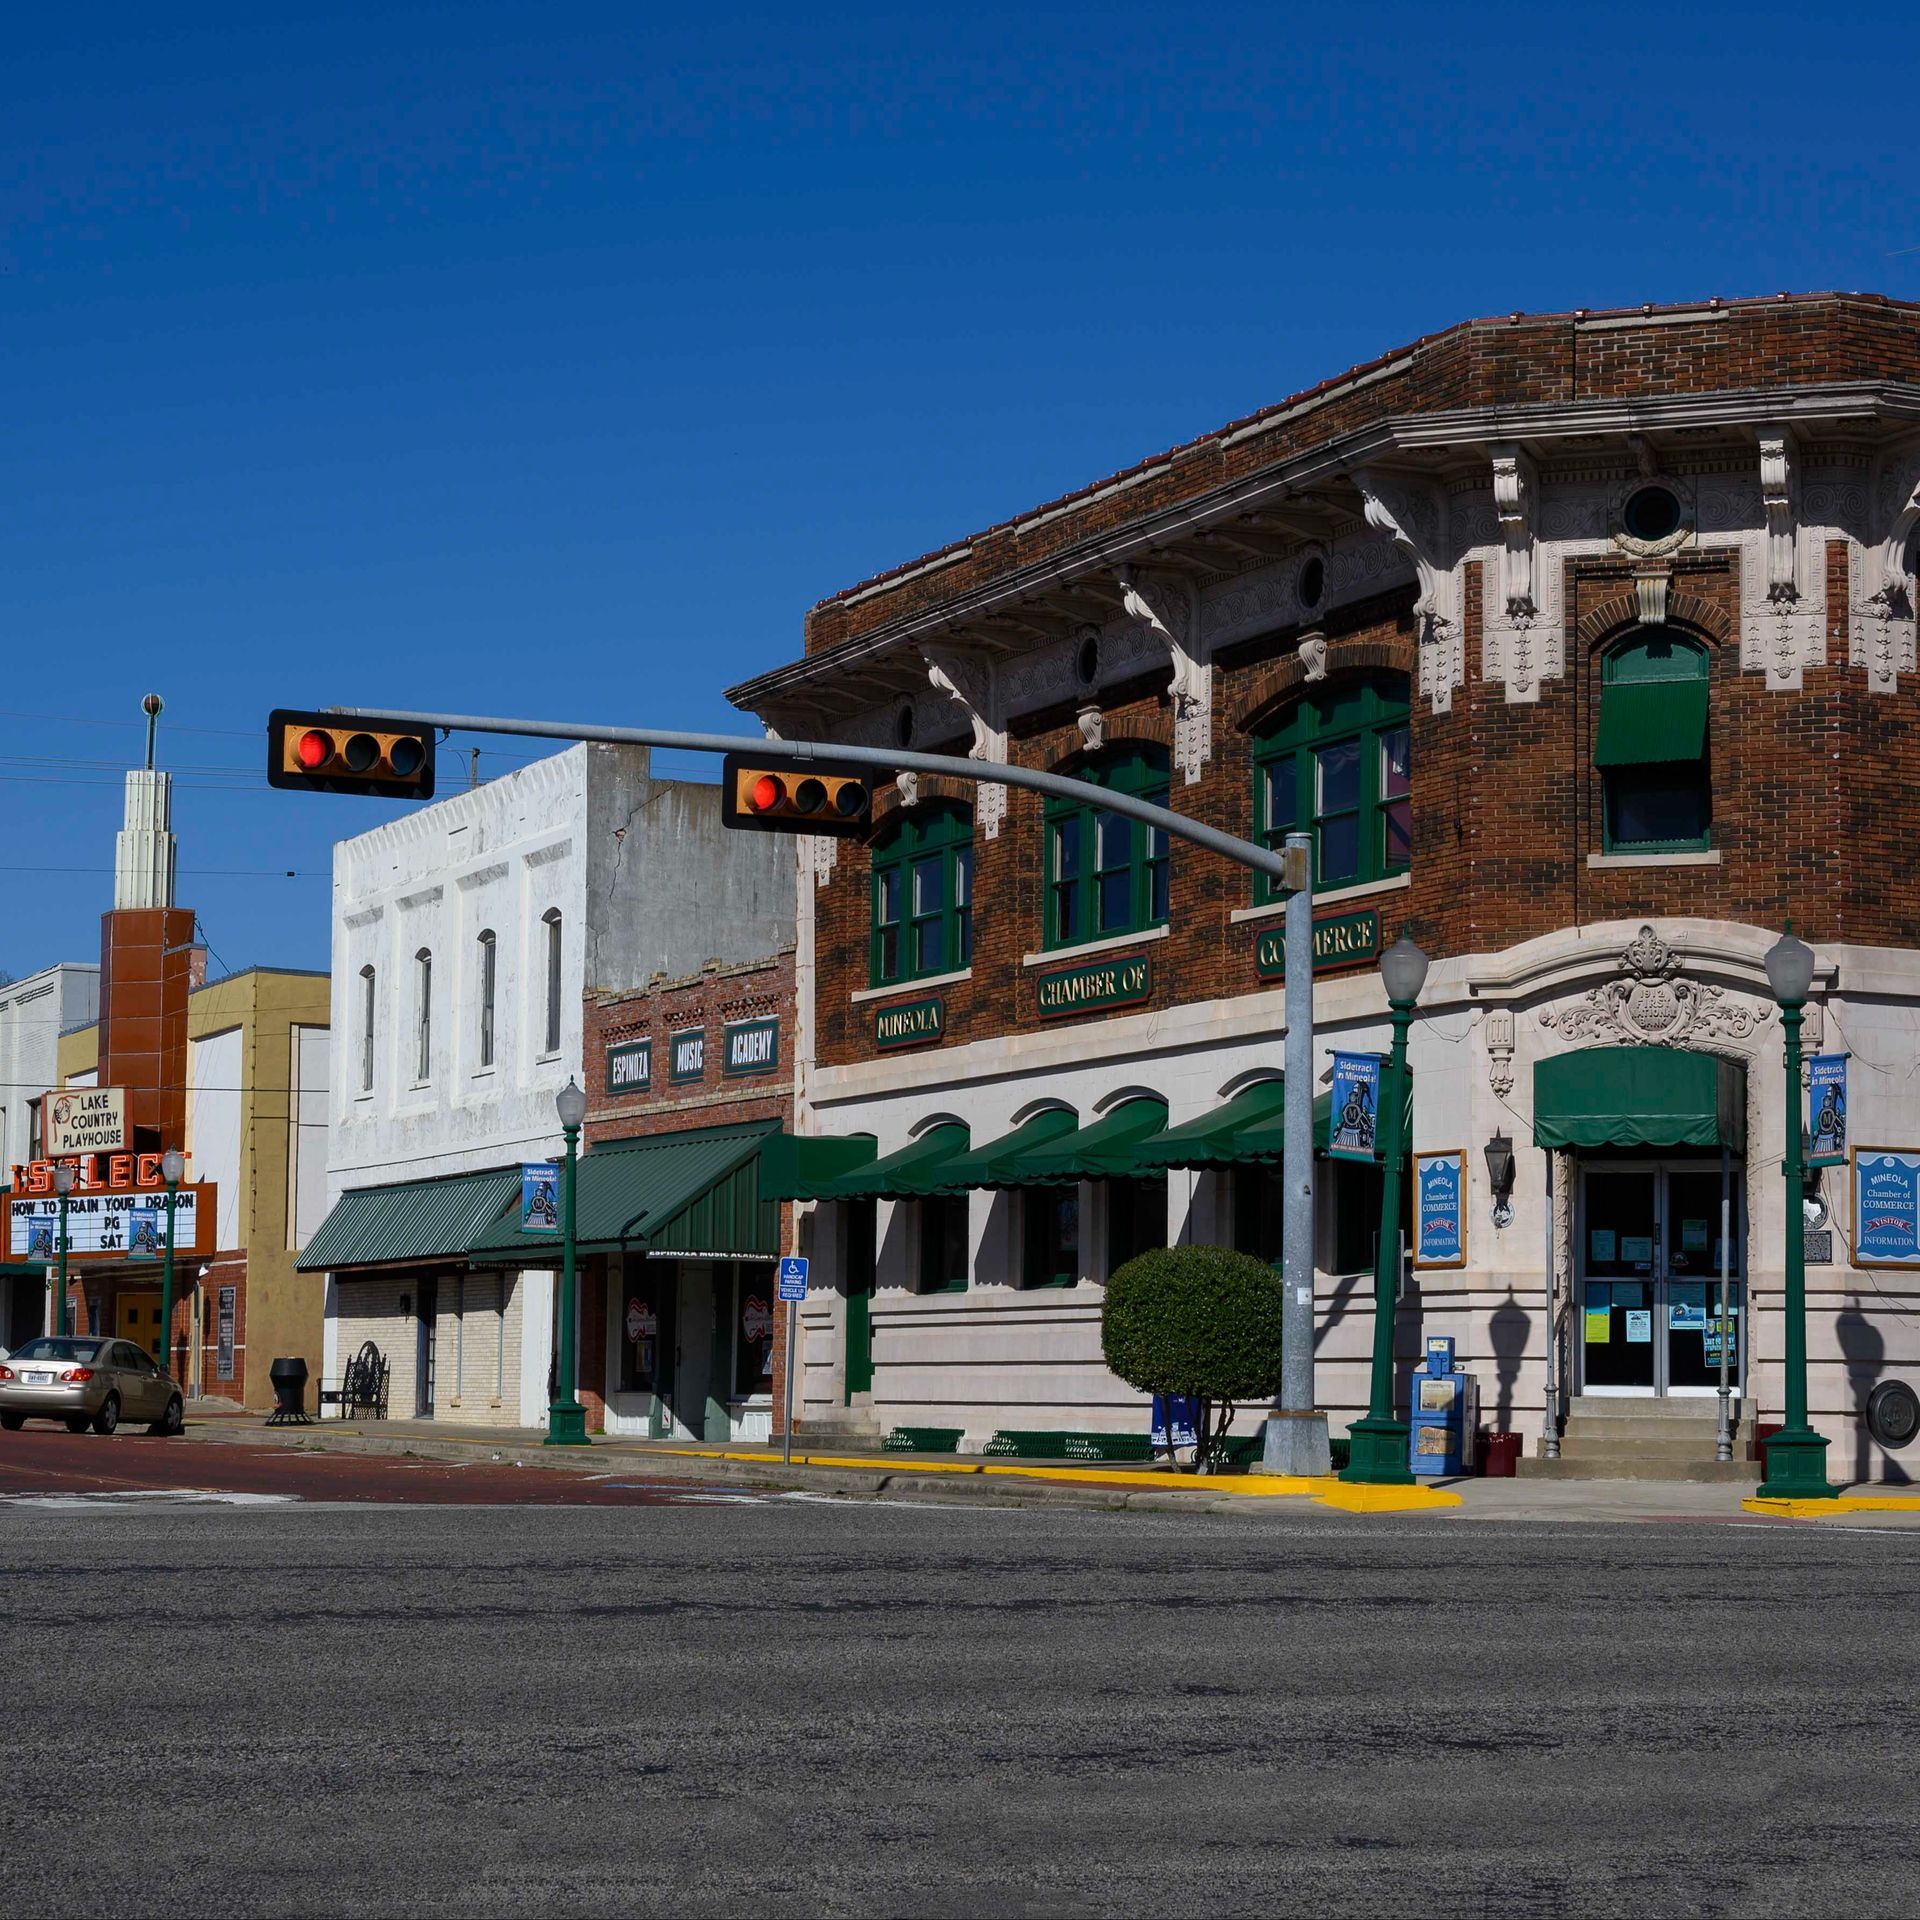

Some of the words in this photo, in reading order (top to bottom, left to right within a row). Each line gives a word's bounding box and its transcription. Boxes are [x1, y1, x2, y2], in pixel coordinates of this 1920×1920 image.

[1260, 920, 1373, 966] COMERCE
[1040, 971, 1117, 1006] CHAMBER
[1123, 964, 1146, 991] OF
[1640, 990, 1665, 999] 1912
[1636, 999, 1671, 1009] FIRST
[1633, 1009, 1677, 1019] NATIONAL
[878, 1006, 939, 1039] MINEOLA
[1640, 1018, 1666, 1029] BANK
[731, 1030, 773, 1065] ACADEMY
[677, 1040, 703, 1072] MUSIC
[612, 1051, 649, 1084] ESPINOZA
[81, 1094, 109, 1111] LAKE
[1348, 1108, 1357, 1120] M
[1823, 1113, 1831, 1125] M
[71, 1112, 118, 1130] COUNTRY
[63, 1129, 121, 1149] PLAYHOUSE
[28, 1152, 192, 1192] SLEC
[527, 1168, 554, 1176] Sidetrack
[1427, 1177, 1453, 1190] MINEOLA
[1870, 1173, 1908, 1189] MINEOLA
[1425, 1192, 1448, 1201] Chamber
[1448, 1192, 1455, 1200] of
[1867, 1189, 1901, 1199] Chamber
[1903, 1190, 1911, 1199] of
[12, 1201, 36, 1216] HOW
[42, 1201, 57, 1215] TO
[145, 1194, 194, 1210] DRAON
[1423, 1202, 1457, 1212] COMMERCE
[1863, 1200, 1915, 1210] COMMERCE
[104, 1216, 120, 1230] PG
[1430, 1219, 1450, 1229] VISITOR
[1875, 1218, 1904, 1229] VISITOR
[54, 1235, 73, 1251] FI
[100, 1234, 123, 1249] SAT
[1423, 1238, 1457, 1247] INFORMATION
[1864, 1236, 1915, 1246] INFORMATION
